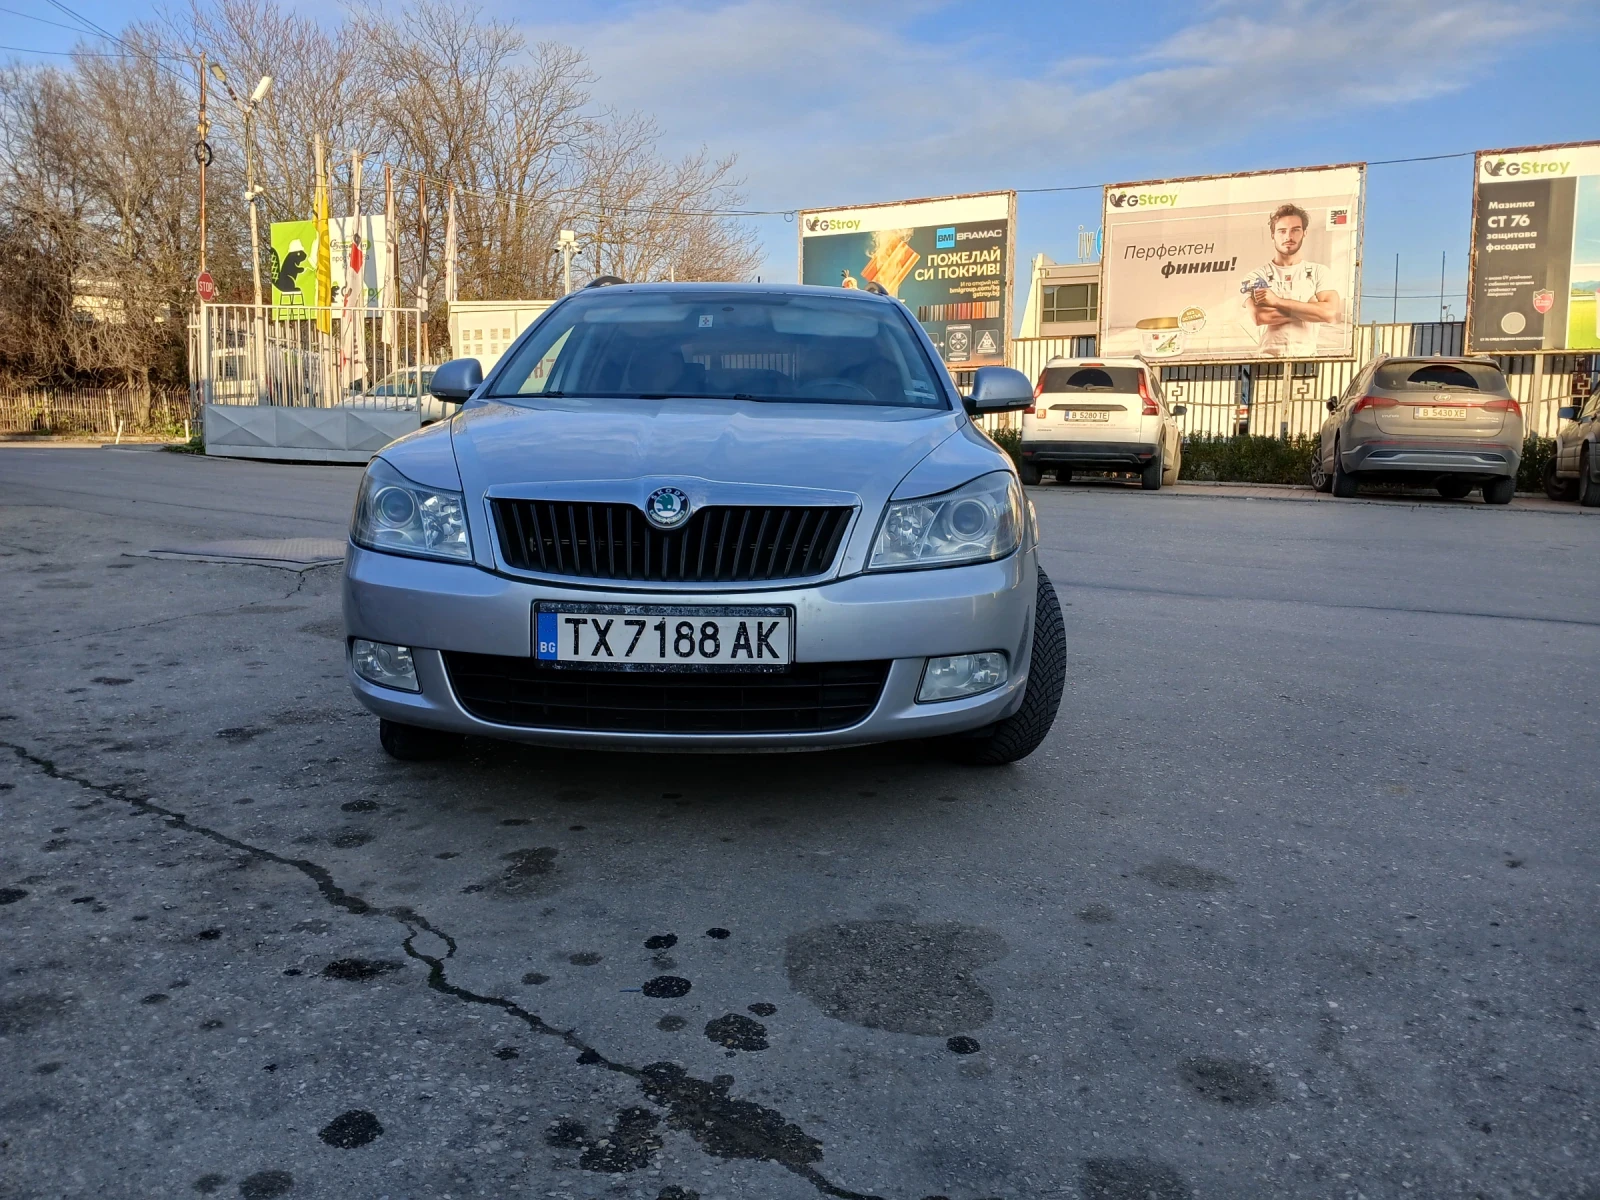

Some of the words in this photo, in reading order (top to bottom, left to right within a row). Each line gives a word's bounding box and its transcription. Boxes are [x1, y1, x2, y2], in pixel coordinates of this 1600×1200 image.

[1506, 161, 1570, 176] GStroy
[1127, 194, 1177, 207] GStroy
[1488, 201, 1535, 209] Мазилка
[820, 220, 860, 231] GStroy
[1510, 214, 1530, 227] 76
[938, 234, 954, 242] BMI
[956, 229, 1002, 240] BRAMAC
[1486, 231, 1537, 240] защитава
[1124, 243, 1215, 261] Перфектен
[1486, 243, 1536, 253] фасадата
[927, 246, 1001, 267] ПОЖЕЛАЙ
[915, 269, 934, 281] СИ
[938, 263, 1000, 279] ПОКРИВ!
[1161, 257, 1237, 279] финиш!
[199, 281, 212, 292] STOP
[1433, 409, 1452, 417] 5430
[1454, 410, 1465, 418] XE
[565, 617, 614, 657] TX
[624, 617, 721, 659] 7188
[730, 621, 780, 659] AK
[540, 641, 556, 653] BG
